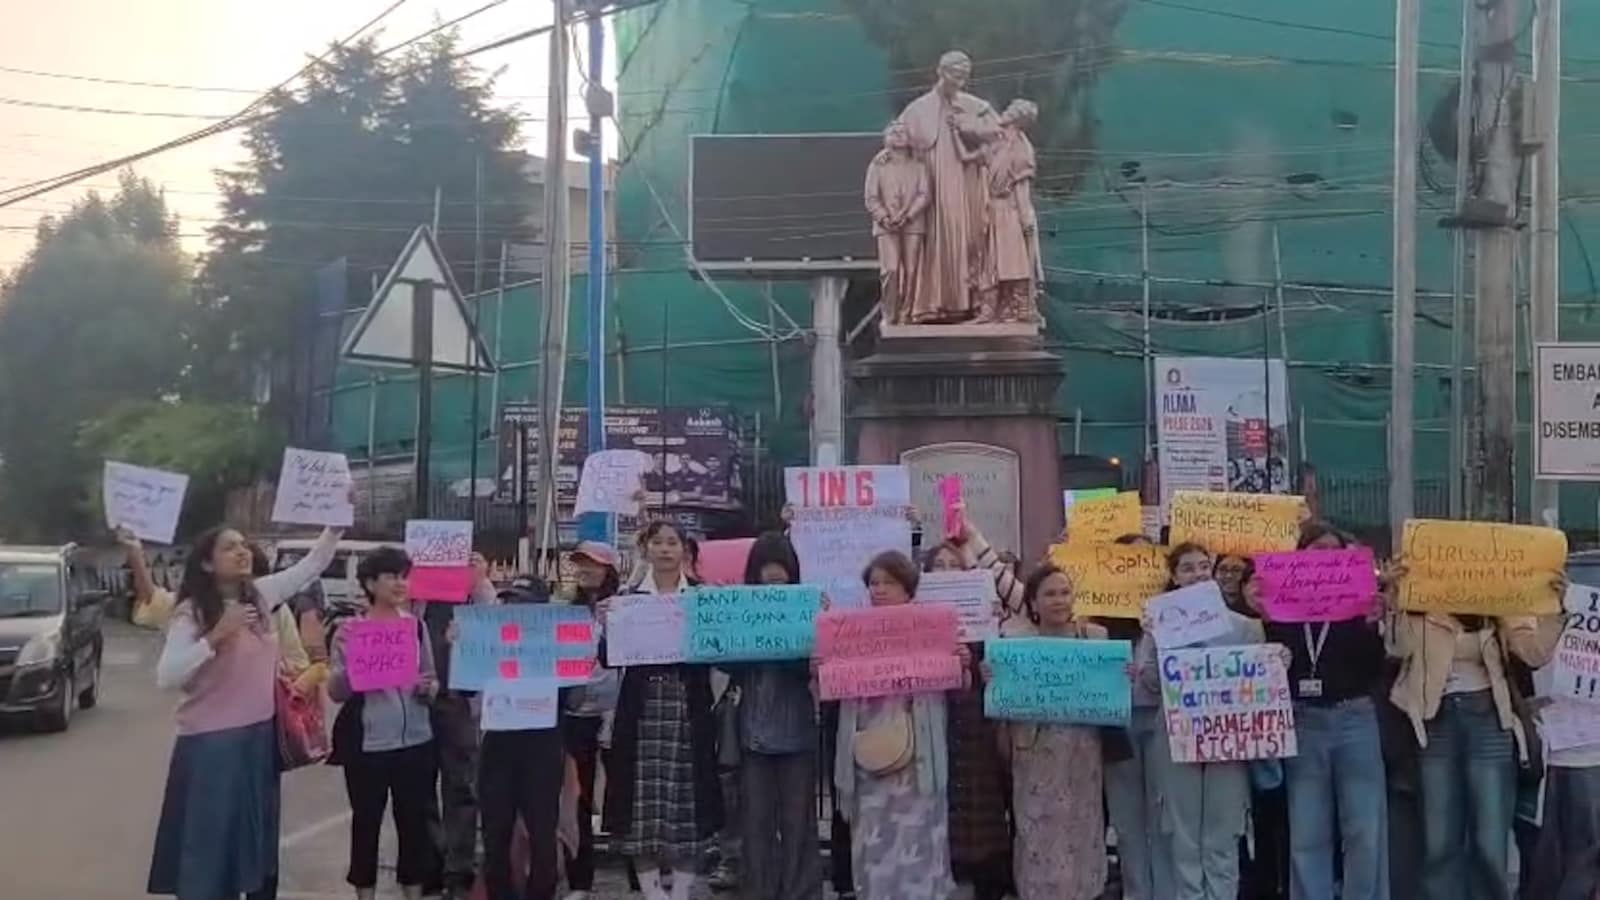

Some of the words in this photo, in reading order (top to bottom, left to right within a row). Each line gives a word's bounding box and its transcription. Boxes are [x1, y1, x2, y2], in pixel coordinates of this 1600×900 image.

[1553, 363, 1600, 381] EMBA
[797, 471, 809, 508] 1
[819, 471, 847, 507] IN
[855, 470, 875, 507] 6
[1095, 545, 1161, 575] Rapist
[357, 631, 408, 647] TAKE
[1163, 654, 1221, 682] Girls
[1165, 682, 1234, 709] Wanna
[1195, 732, 1286, 761] RIGHTS!
